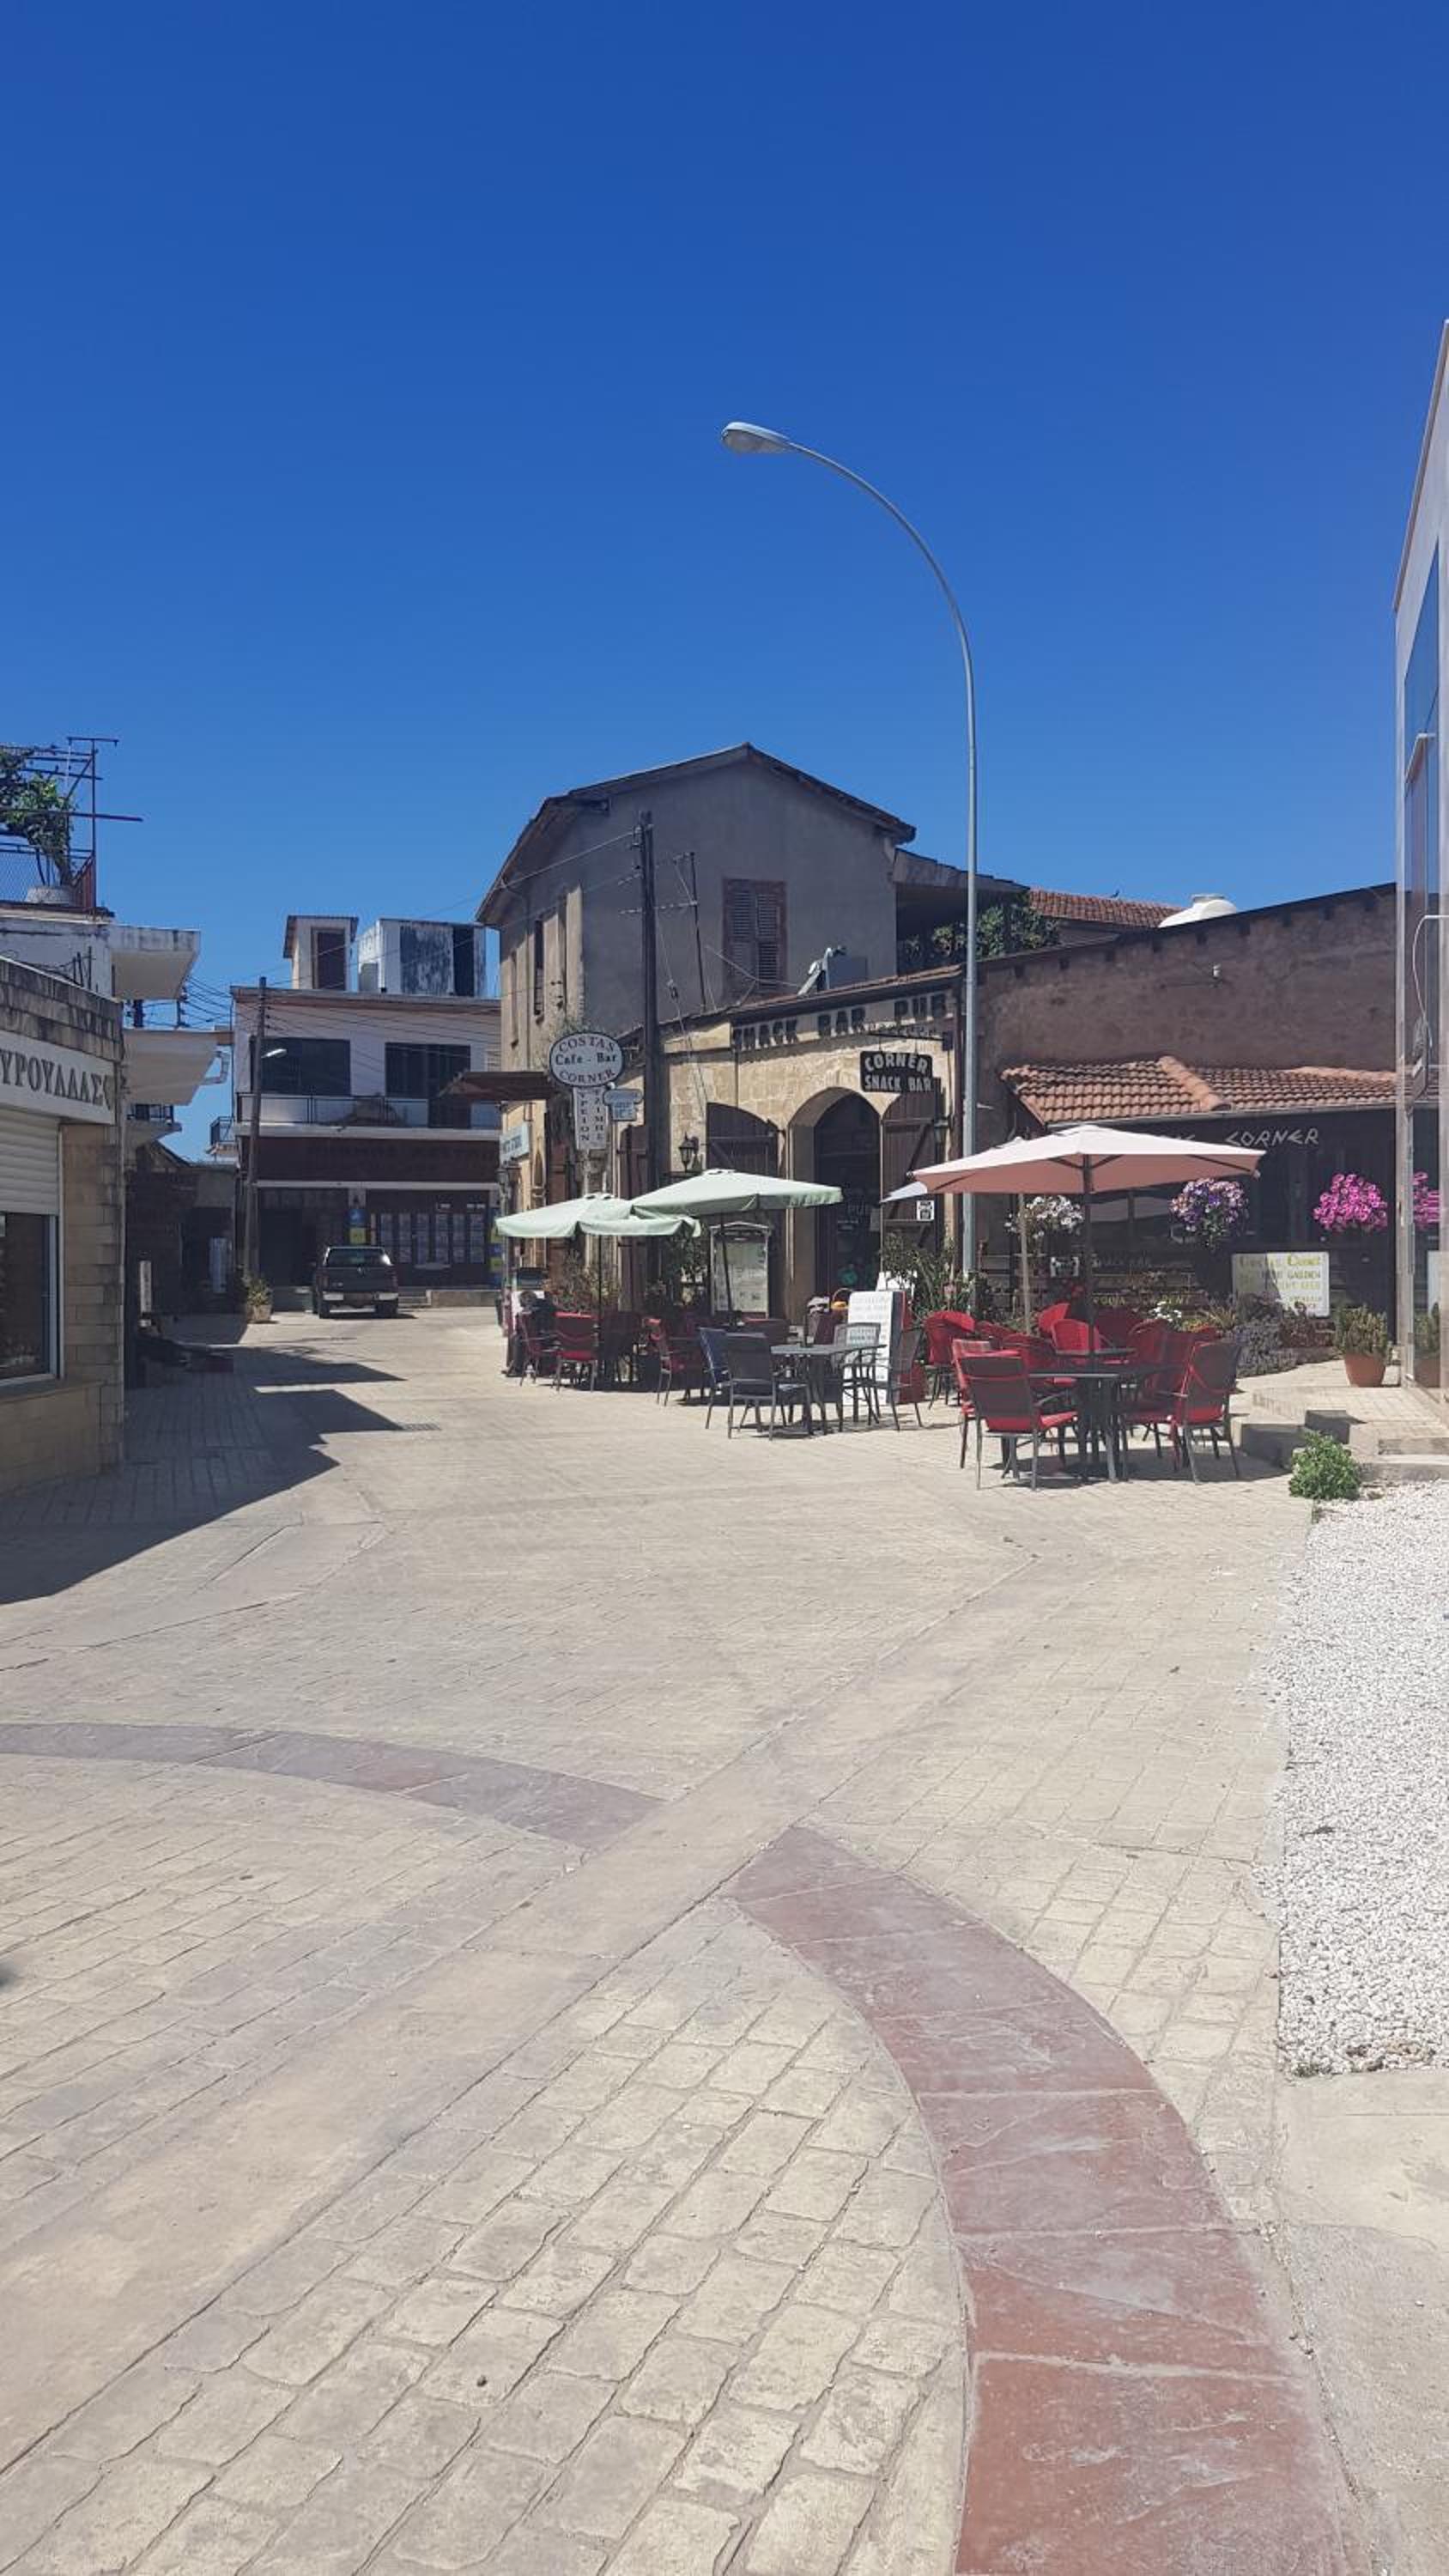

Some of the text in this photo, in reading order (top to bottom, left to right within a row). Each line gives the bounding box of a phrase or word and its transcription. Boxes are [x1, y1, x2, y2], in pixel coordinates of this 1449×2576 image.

[818, 1008, 866, 1036] BAR
[559, 1036, 615, 1053] COSTAS
[596, 1053, 616, 1063] Bar
[864, 1053, 929, 1074] CORNER
[559, 1069, 615, 1082] CORNER
[864, 1074, 933, 1092] SNACK BAR
[1225, 1127, 1319, 1148] CORNER
